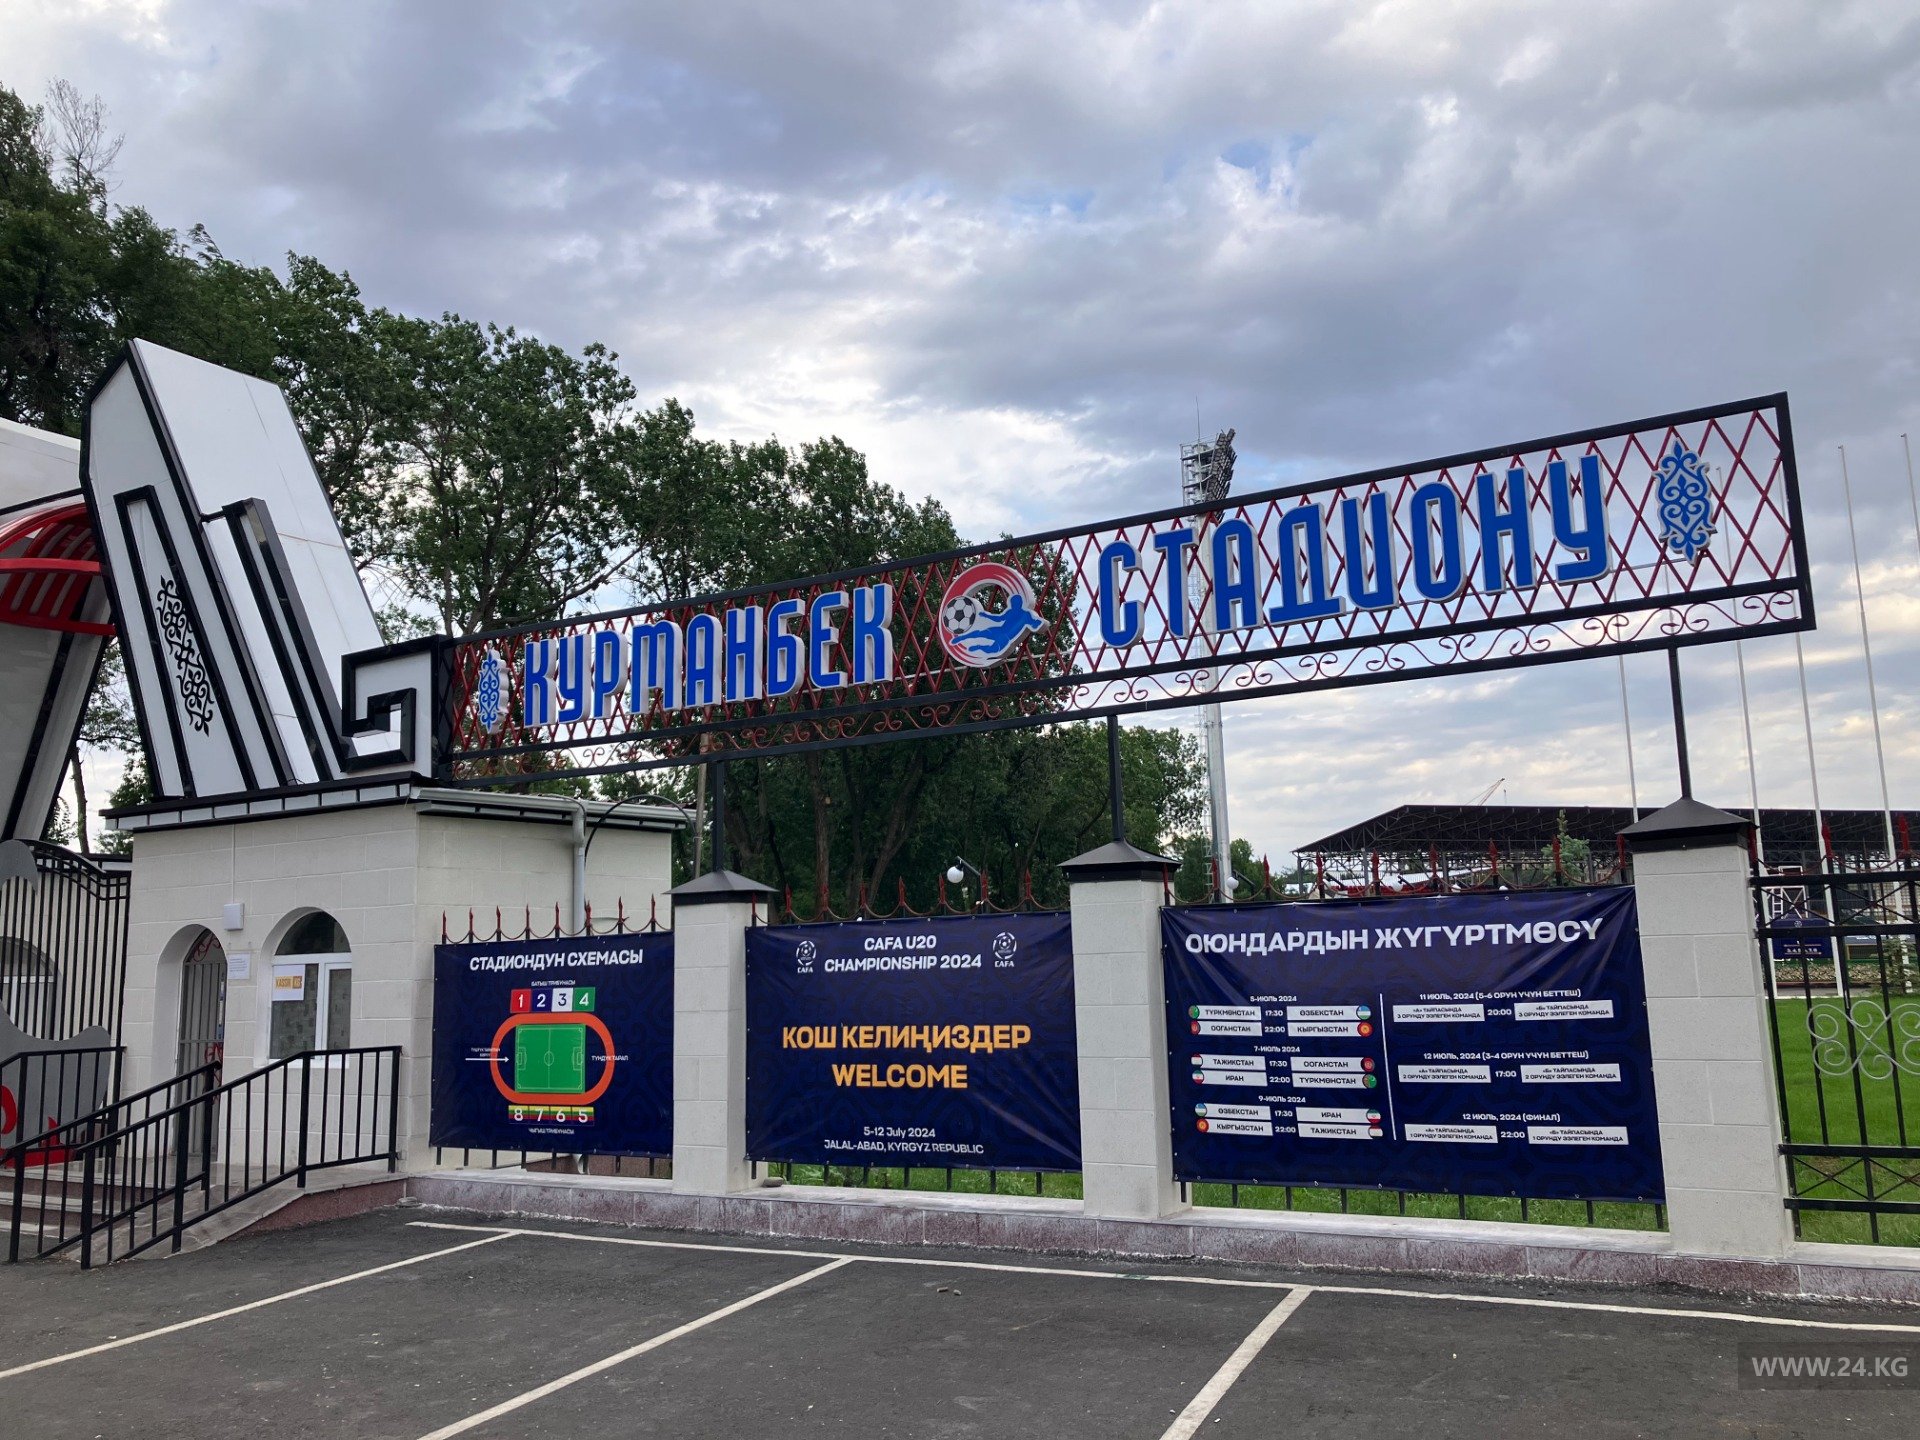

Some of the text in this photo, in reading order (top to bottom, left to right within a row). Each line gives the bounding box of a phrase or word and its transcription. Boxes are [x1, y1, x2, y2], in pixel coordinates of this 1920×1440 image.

[523, 453, 1611, 728] КУРМАНБЕК СТАДИОНУ
[865, 935, 937, 951] CAFA U20
[1185, 918, 1603, 956] ОЮНДАРДЫН ЖҮГҮРТМӨСҮ
[469, 949, 644, 972] СТАДИОНДУН СХЕМАСЫ
[824, 954, 982, 972] CHAMPIONSHIP 2024
[994, 960, 1014, 968] CAFA
[519, 993, 589, 1008] 1 2 3 4
[782, 1025, 1031, 1054] КОШ КЕЛИҢИЗДЕР
[1482, 1052, 1500, 1060] (3-4
[1550, 1050, 1589, 1059] БЕТТЕШ)
[832, 1064, 968, 1089] WELCOME
[514, 1108, 588, 1123] 8 7 6 5
[1523, 1113, 1561, 1122] (ФИНАЛ)
[863, 1127, 936, 1139] 5-12 July 2024
[1216, 1124, 1264, 1132] КЫРГЫЗСТАН
[1311, 1127, 1357, 1135] ТАЖИКСТАН
[824, 1139, 984, 1154] JALAL-ABAD, KYRGYZ REPUBLIC
